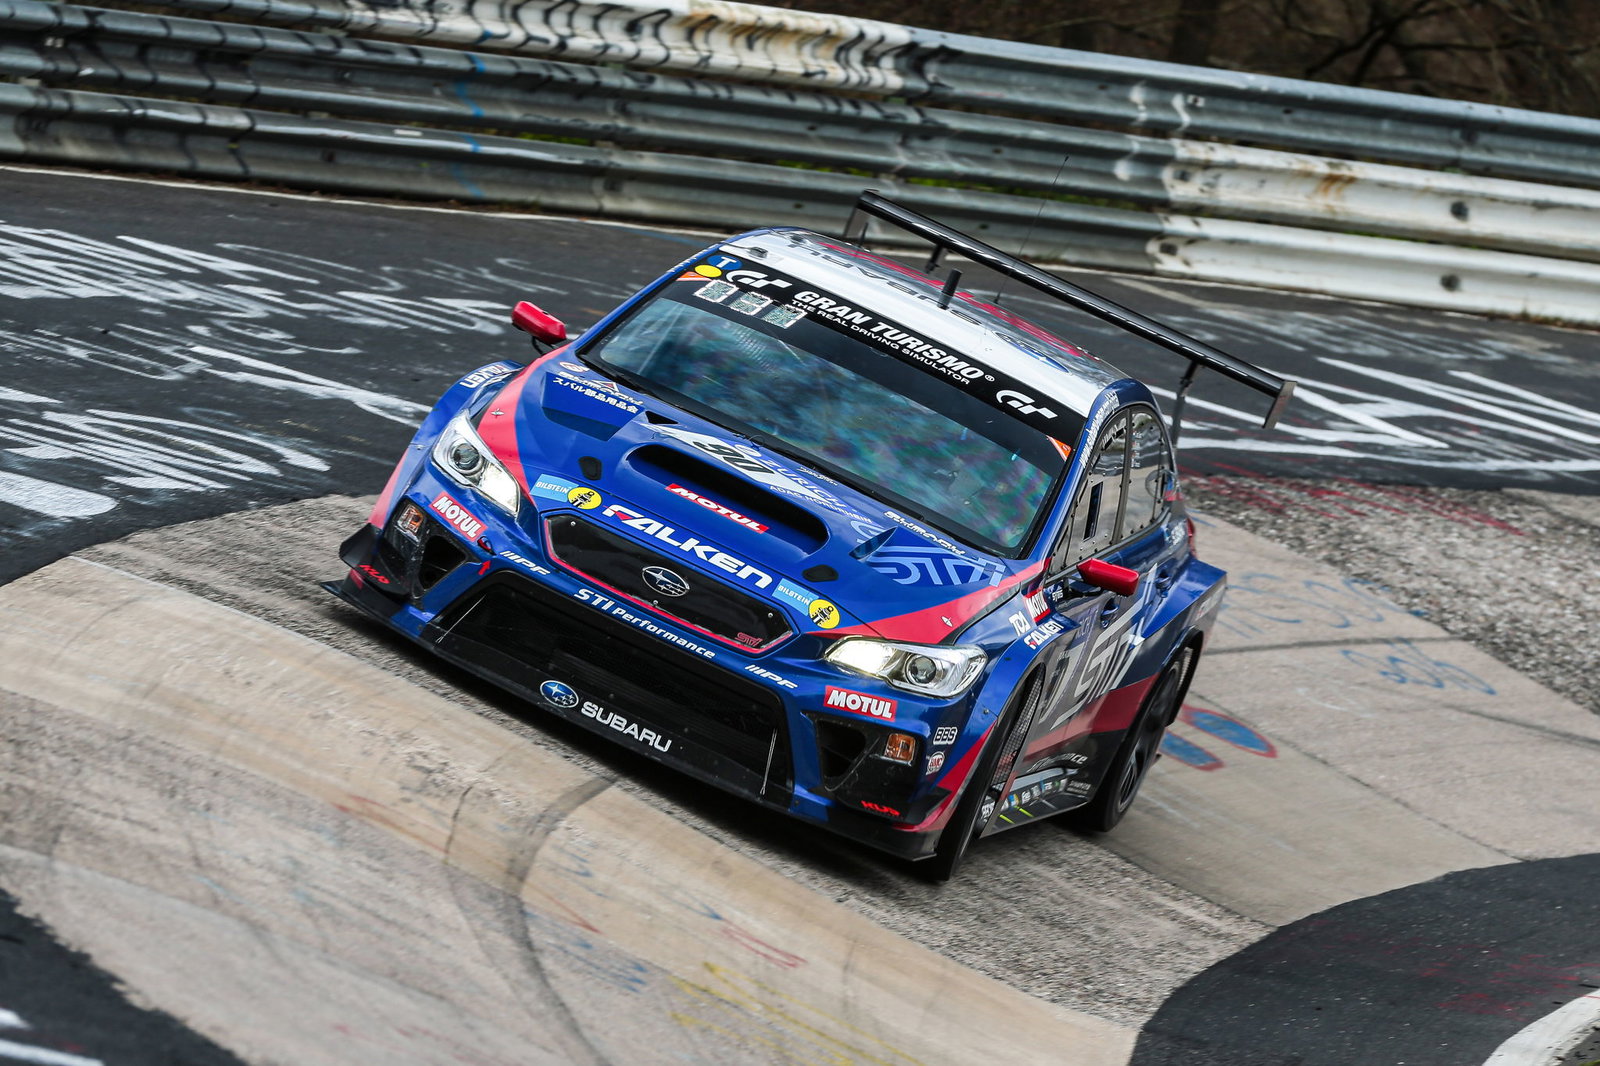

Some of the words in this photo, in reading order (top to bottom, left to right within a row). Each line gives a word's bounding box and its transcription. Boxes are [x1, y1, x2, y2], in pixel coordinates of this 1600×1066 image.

[716, 256, 737, 268] T
[793, 291, 872, 326] GRAN
[791, 299, 817, 313] THE
[817, 308, 849, 328] REAL
[851, 322, 900, 351] DRIVING
[902, 347, 971, 385] SIMULATOR
[535, 480, 571, 495] BILSTEIN
[760, 457, 848, 507] ZURICH
[769, 485, 803, 500] ADAC
[432, 495, 483, 538] MOTUL
[670, 486, 764, 532] MOTUL
[601, 504, 773, 590] FALKEN
[776, 583, 811, 607] BILSTEIN
[573, 587, 613, 611] STI
[612, 606, 715, 659] Performance
[1024, 620, 1064, 650] FALKEN
[826, 690, 894, 719] MOTUL
[580, 700, 673, 753] SUBARU
[933, 726, 958, 745] BBS
